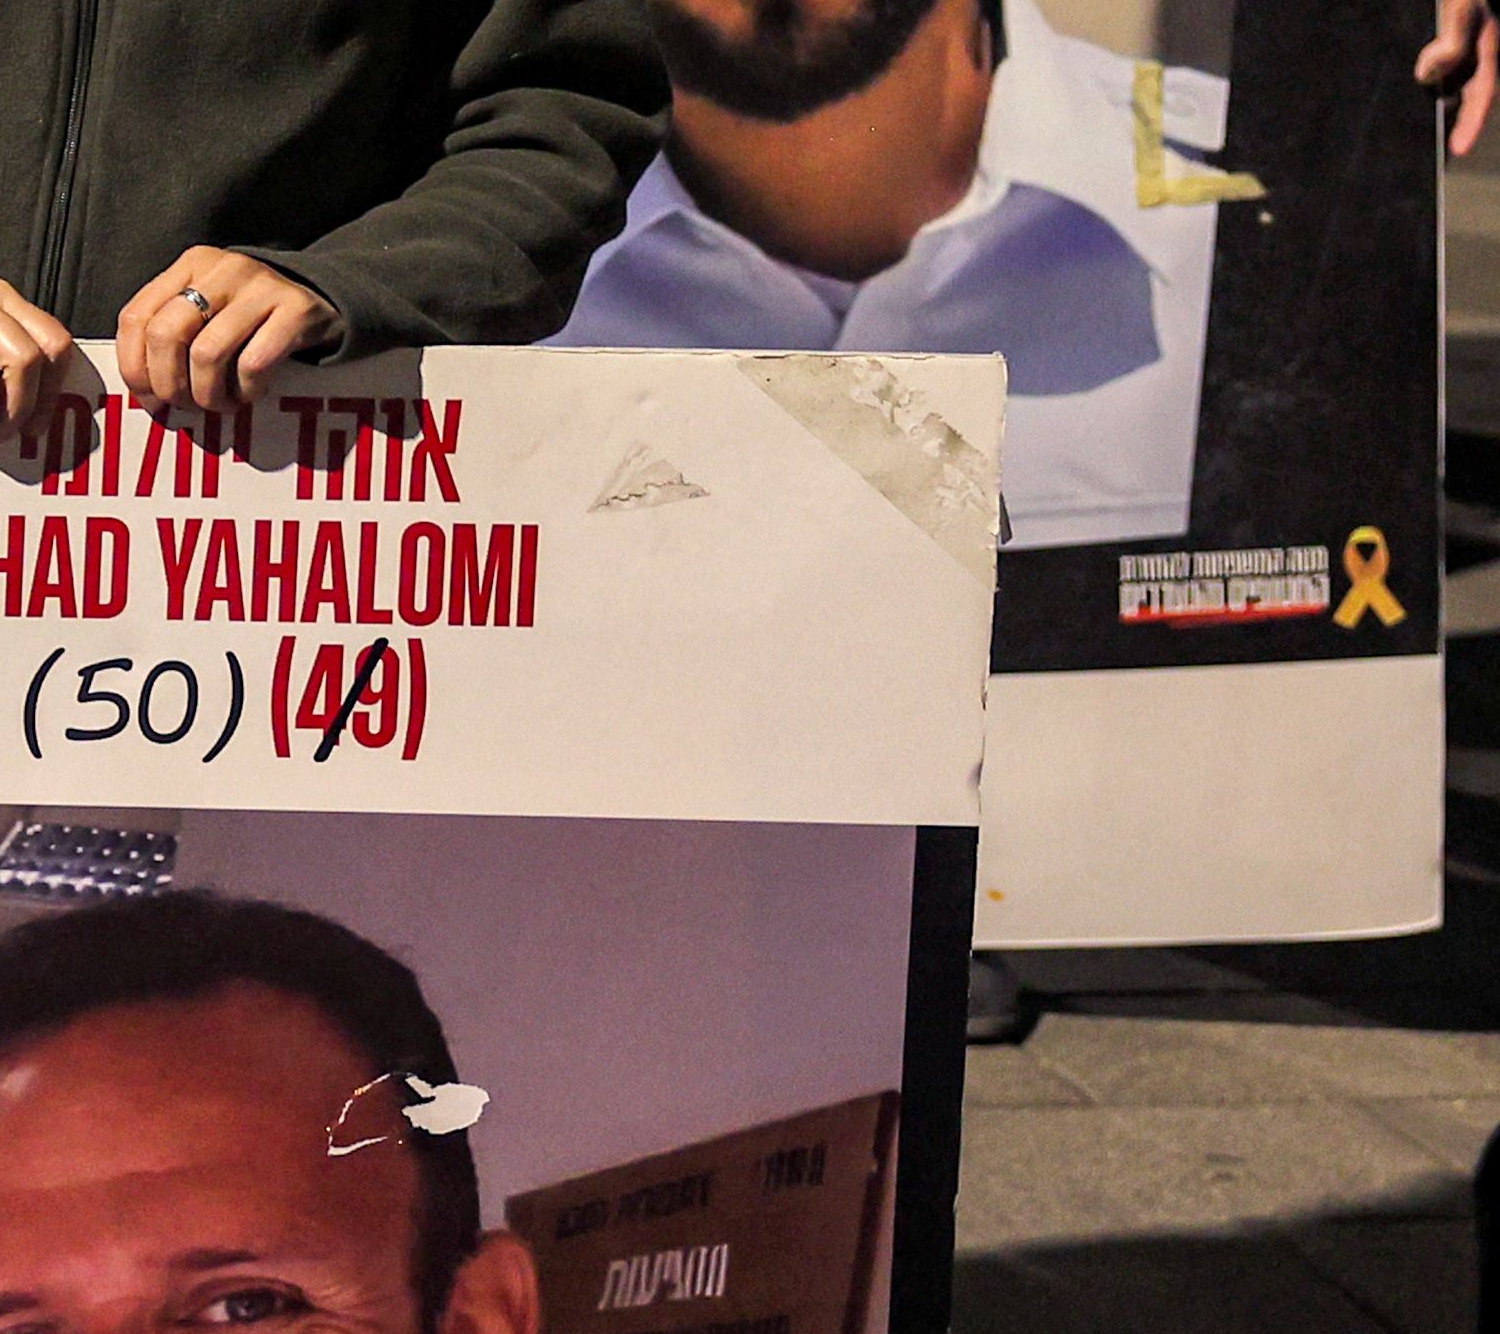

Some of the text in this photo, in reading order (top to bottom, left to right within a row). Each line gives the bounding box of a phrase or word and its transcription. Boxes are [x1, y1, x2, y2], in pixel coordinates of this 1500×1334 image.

[280, 396, 464, 504] אוהד
[156, 516, 540, 628] YAHALOMI
[22, 635, 428, 764] (50) (49)
